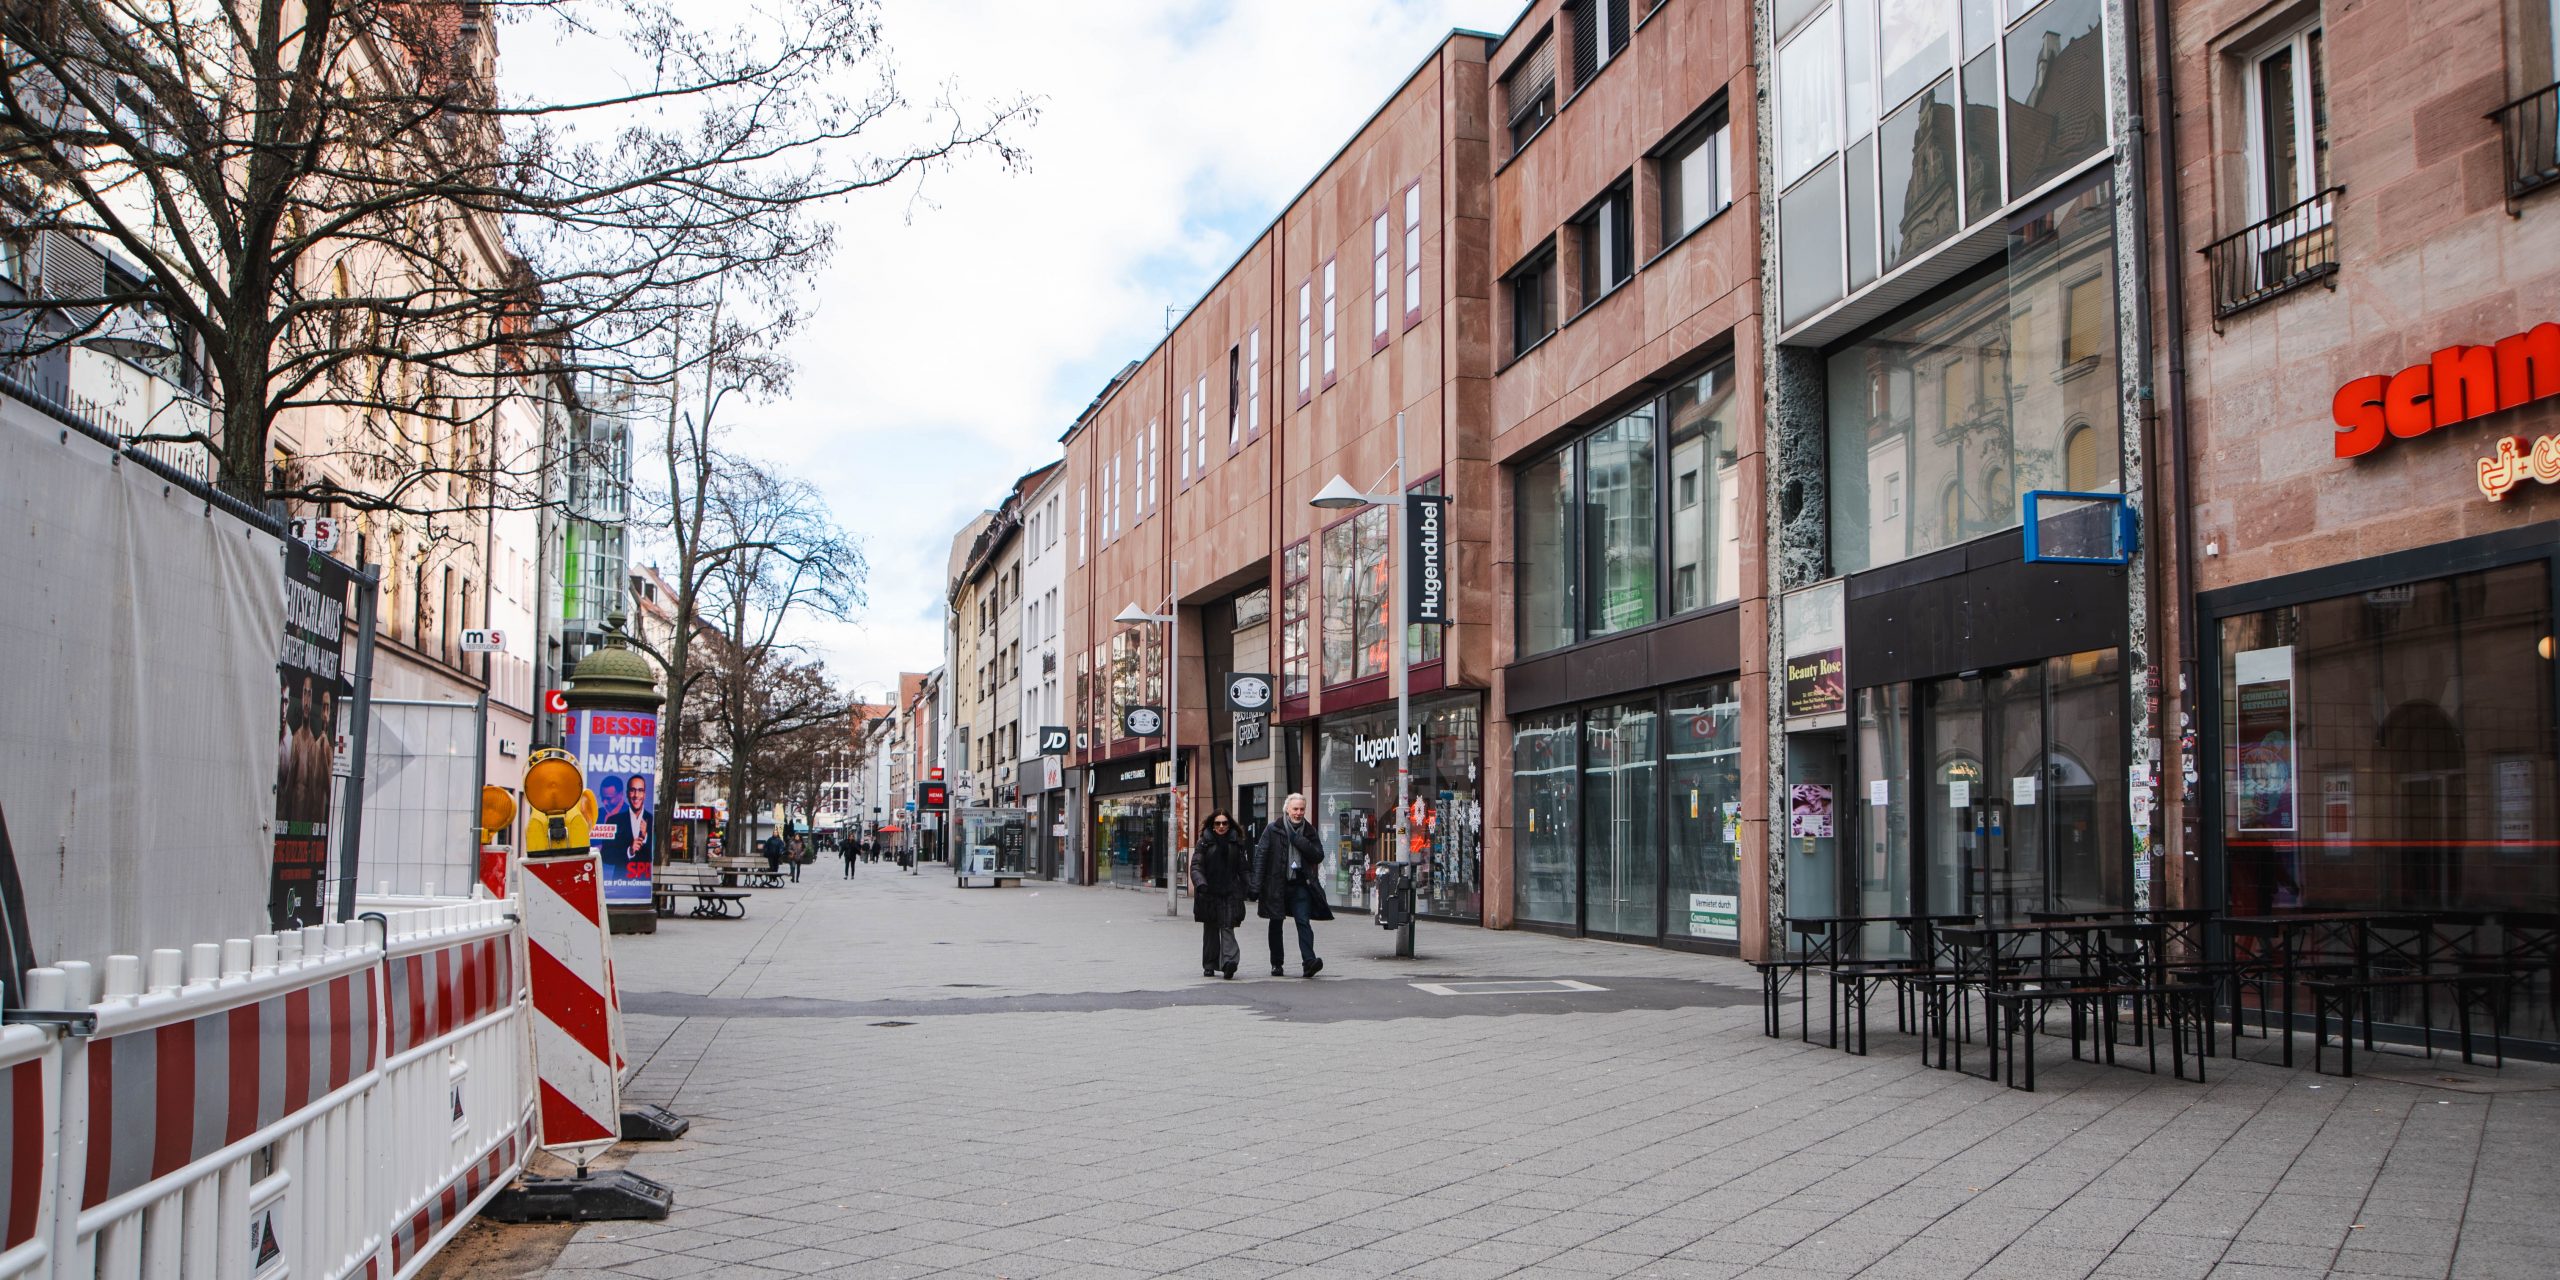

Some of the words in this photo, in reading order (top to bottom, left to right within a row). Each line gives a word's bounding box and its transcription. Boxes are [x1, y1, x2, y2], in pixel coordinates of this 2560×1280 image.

[1420, 501, 1442, 618] Hugendubel
[286, 575, 343, 643] EUTSCHLANDS
[2131, 626, 2146, 647] 65
[281, 630, 306, 671] ÄRTESTE
[1788, 664, 1819, 682] Beauty
[1820, 658, 1842, 676] Rose
[591, 716, 656, 737] BESSER
[1239, 723, 1260, 747] GRENE
[609, 735, 644, 755] MIT
[1042, 732, 1067, 749] JD
[588, 754, 655, 775] NASSER
[613, 878, 627, 887] FÜR
[1695, 899, 1718, 908] Vermietet
[1718, 900, 1732, 909] durch
